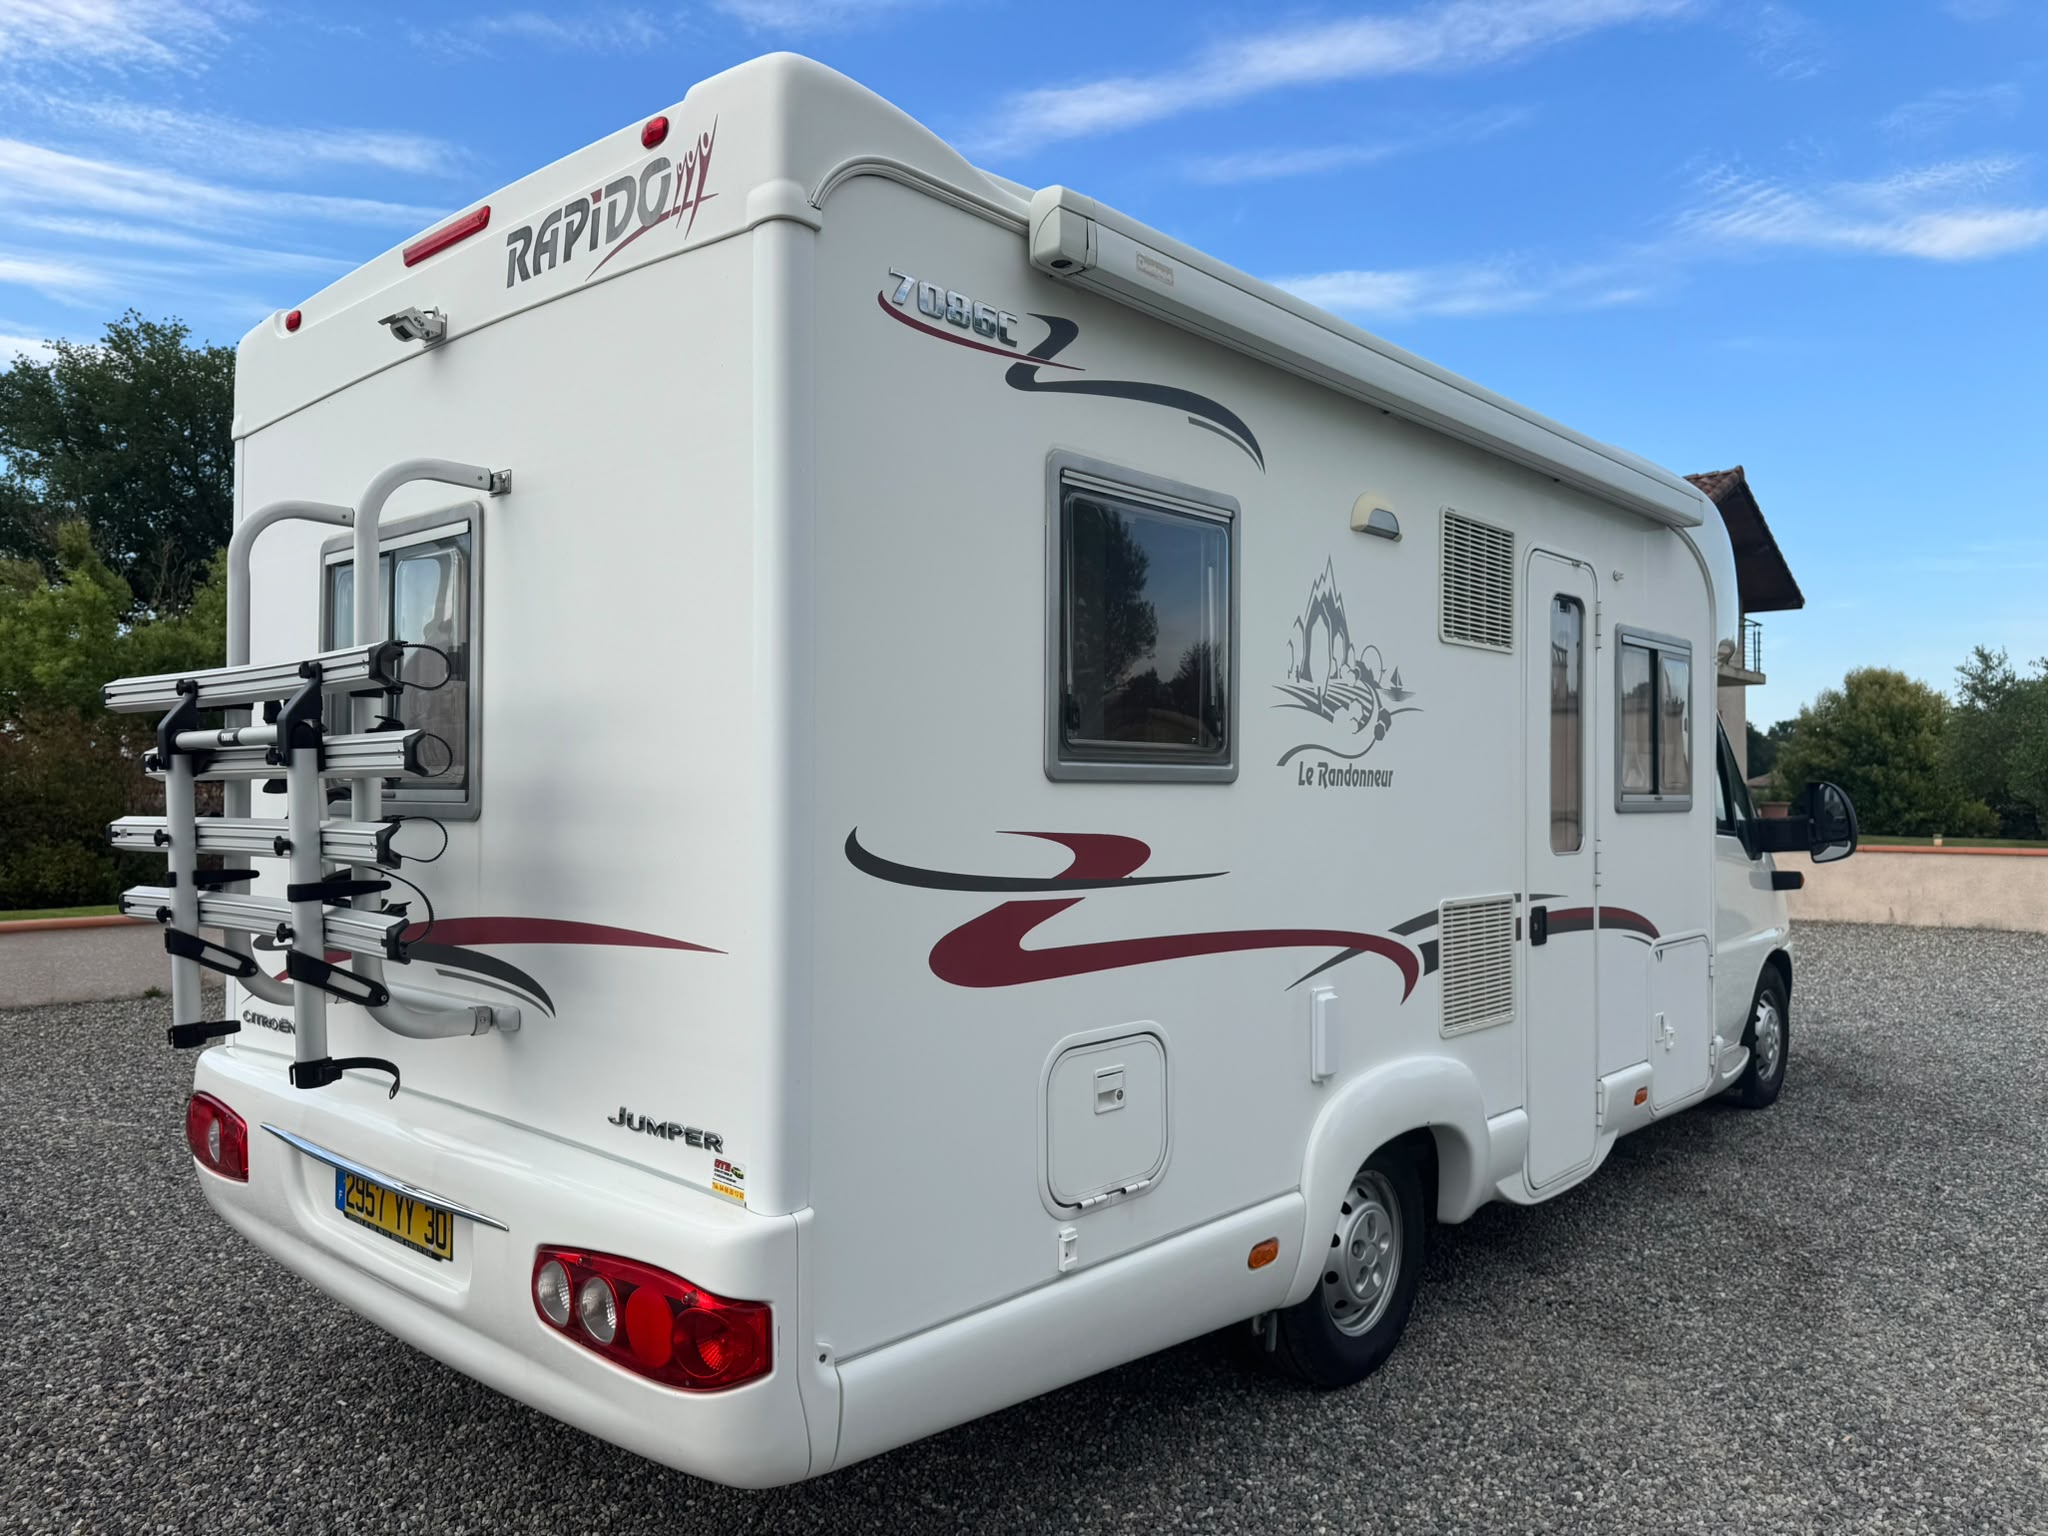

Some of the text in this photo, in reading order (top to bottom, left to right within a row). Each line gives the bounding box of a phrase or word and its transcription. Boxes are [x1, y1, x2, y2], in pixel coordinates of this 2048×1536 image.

[888, 267, 1018, 348] 7086C
[1298, 761, 1393, 789] Le Randonneur
[607, 1105, 723, 1154] JUMPER
[346, 1174, 385, 1222] 2957
[395, 1194, 414, 1235] YY
[424, 1205, 447, 1250] 30
